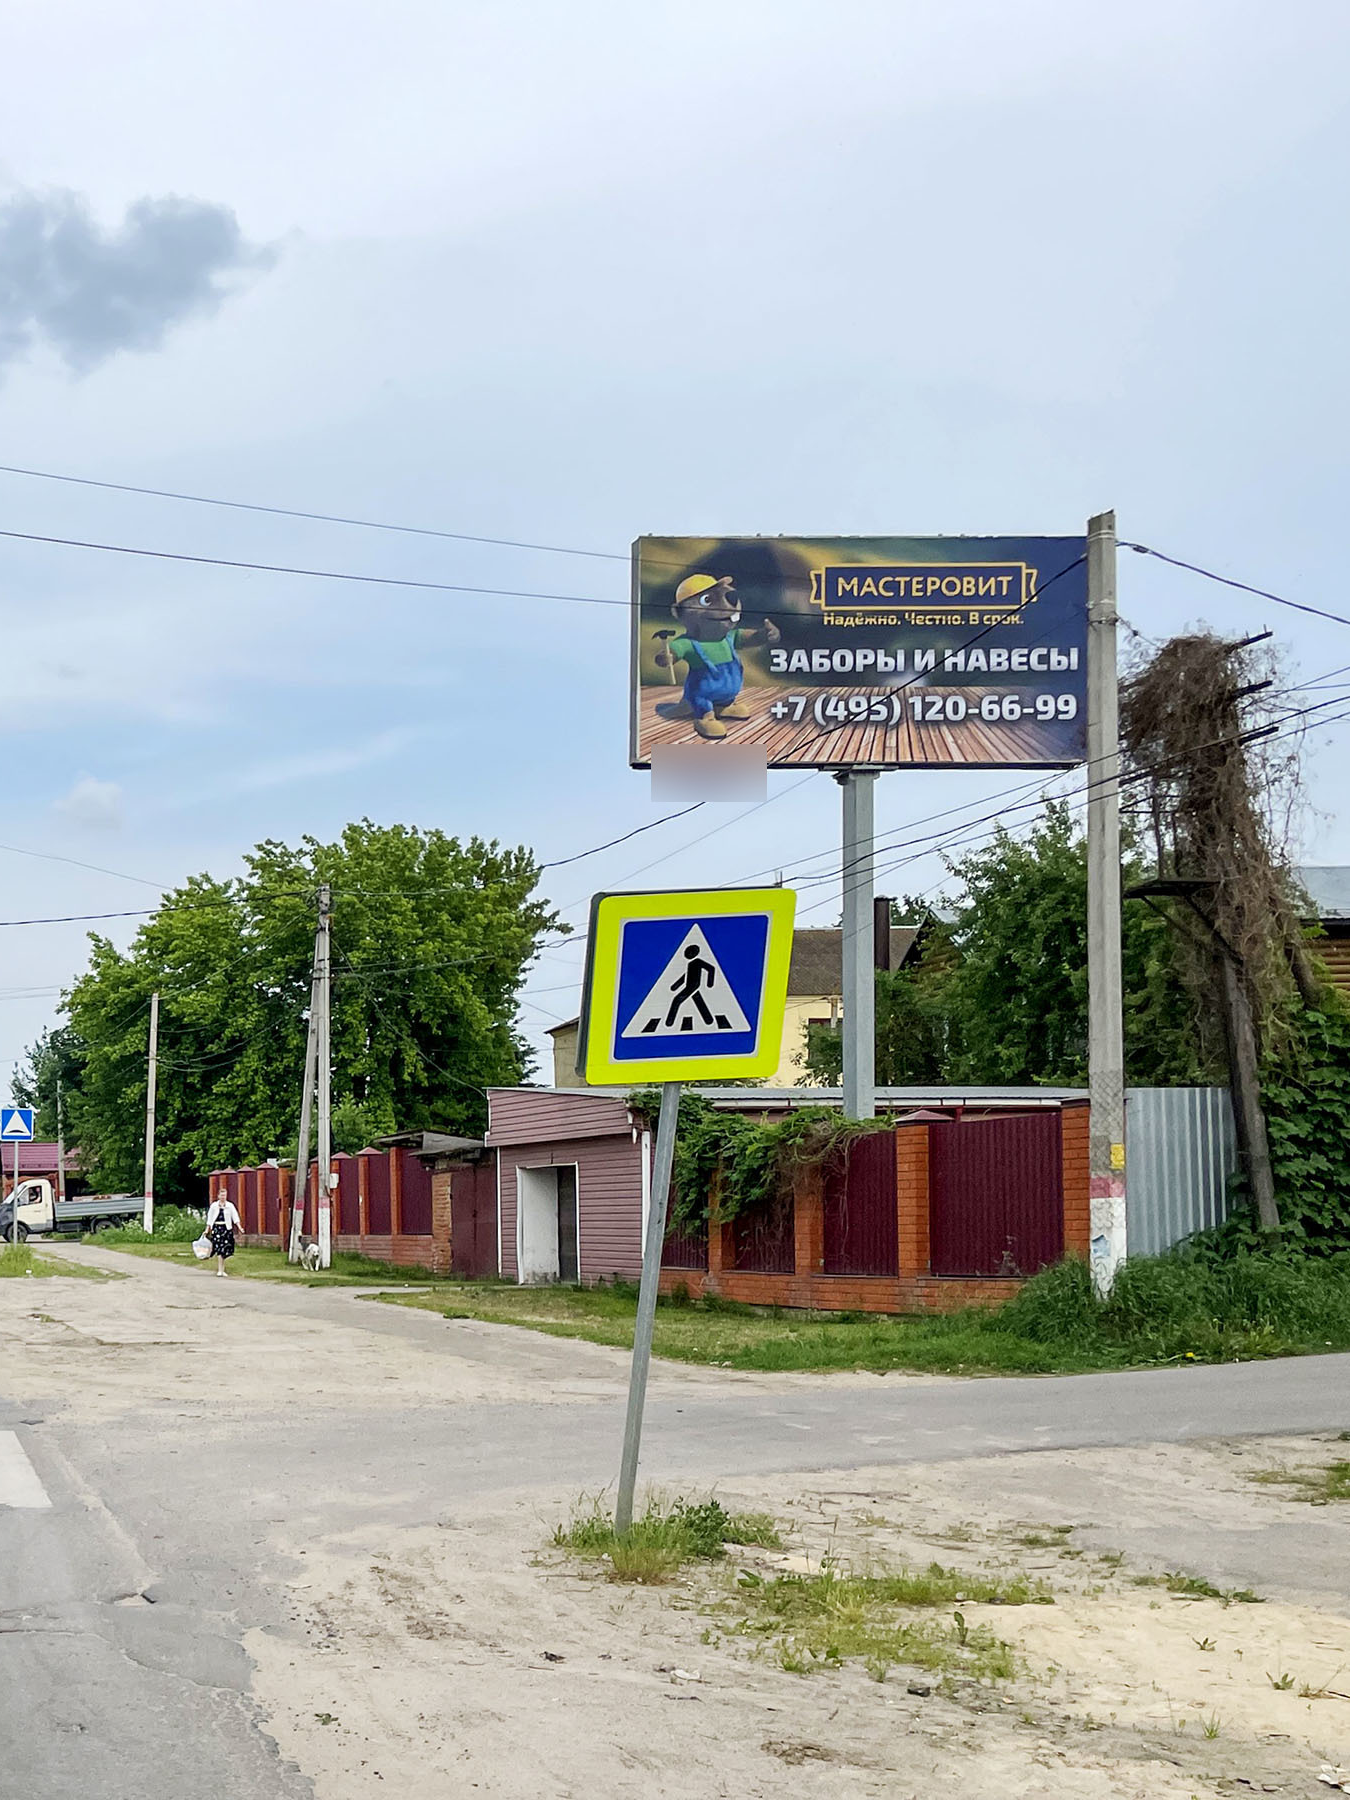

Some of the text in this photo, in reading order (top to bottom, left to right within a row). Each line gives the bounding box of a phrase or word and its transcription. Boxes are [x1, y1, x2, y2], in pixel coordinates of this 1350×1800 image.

[837, 576, 1013, 597] МАСТЕРОВИТ
[823, 612, 1024, 628] Надёжно. Честно. В срок.
[770, 647, 1079, 673] ЗАБОРЫ И НАВЕСЫ
[770, 694, 1078, 726] +7 (495) 120-66-99
